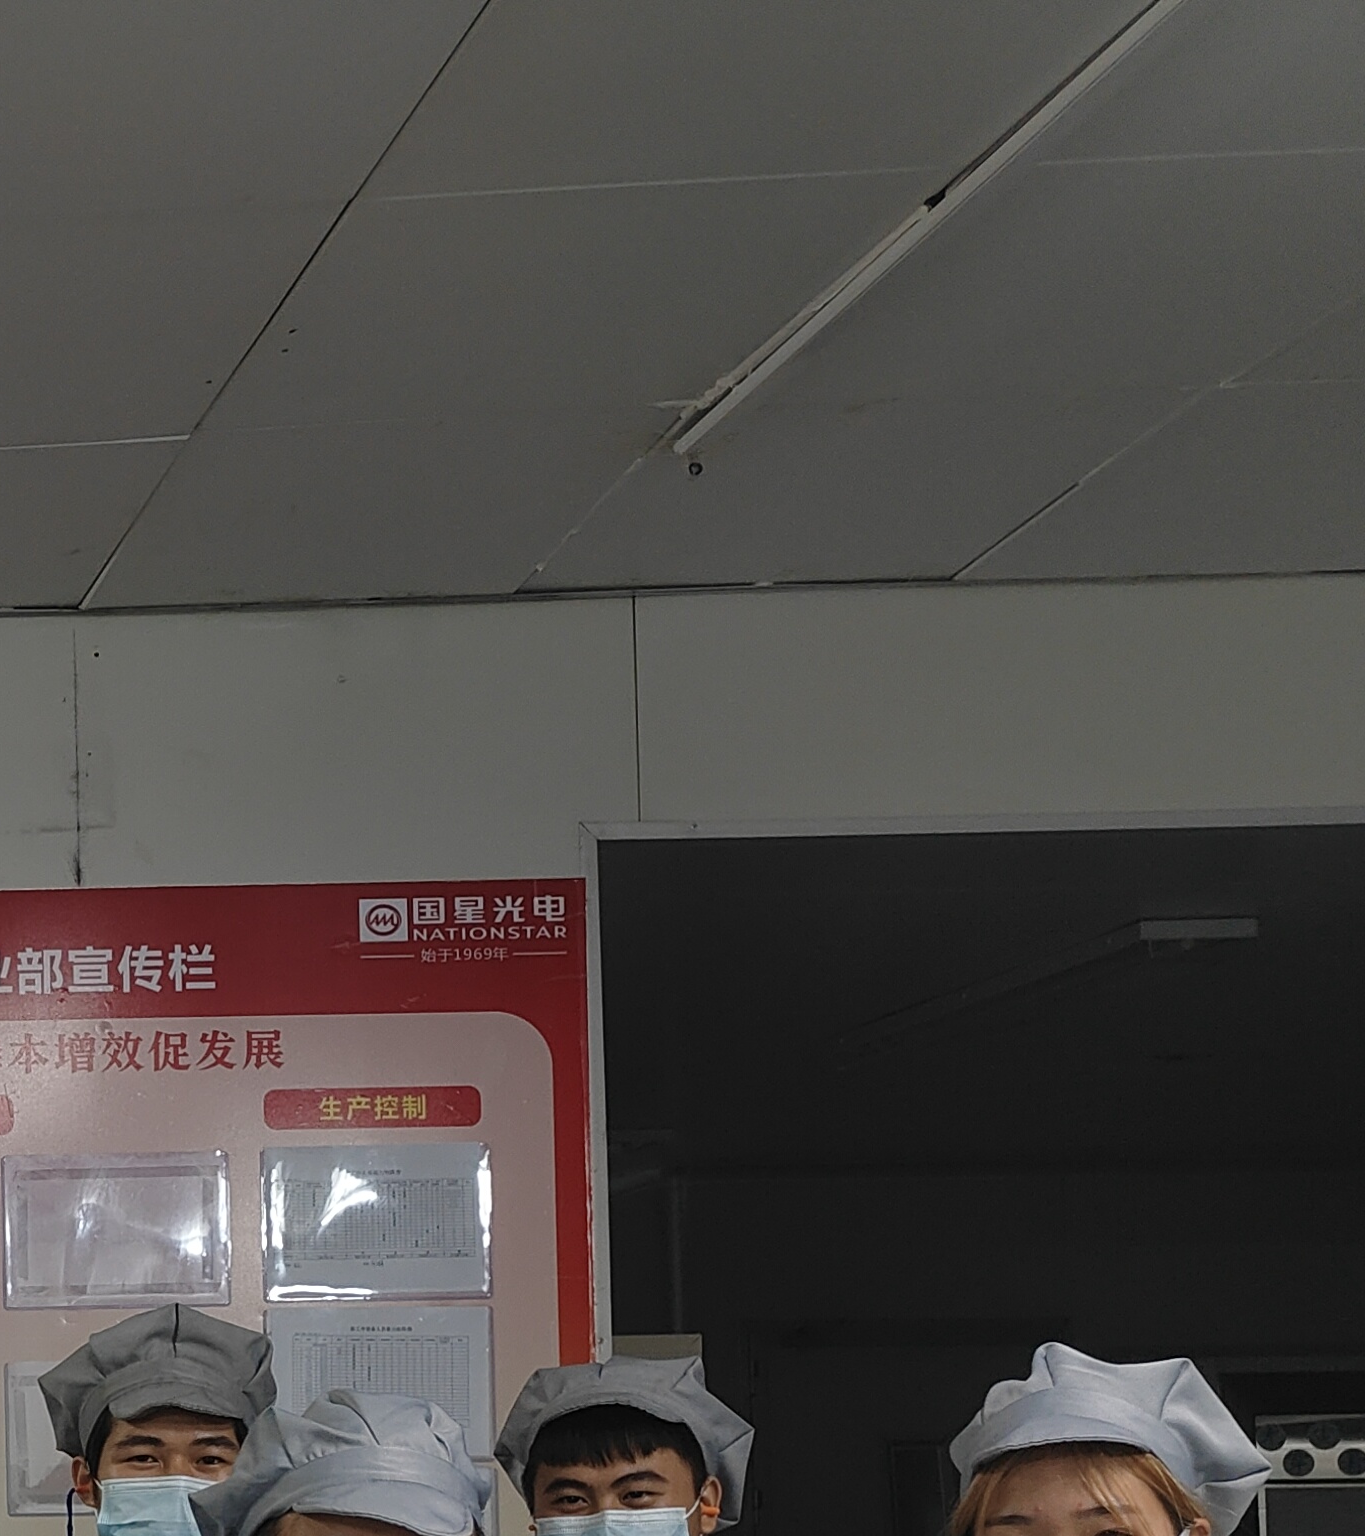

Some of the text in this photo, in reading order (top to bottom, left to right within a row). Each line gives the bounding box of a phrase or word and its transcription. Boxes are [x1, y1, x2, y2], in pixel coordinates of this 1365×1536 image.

[411, 894, 566, 924] 国星光电
[412, 925, 567, 941] NATIONSTAR
[419, 946, 510, 964] 始于1969年
[318, 1094, 428, 1122] 生产控制
